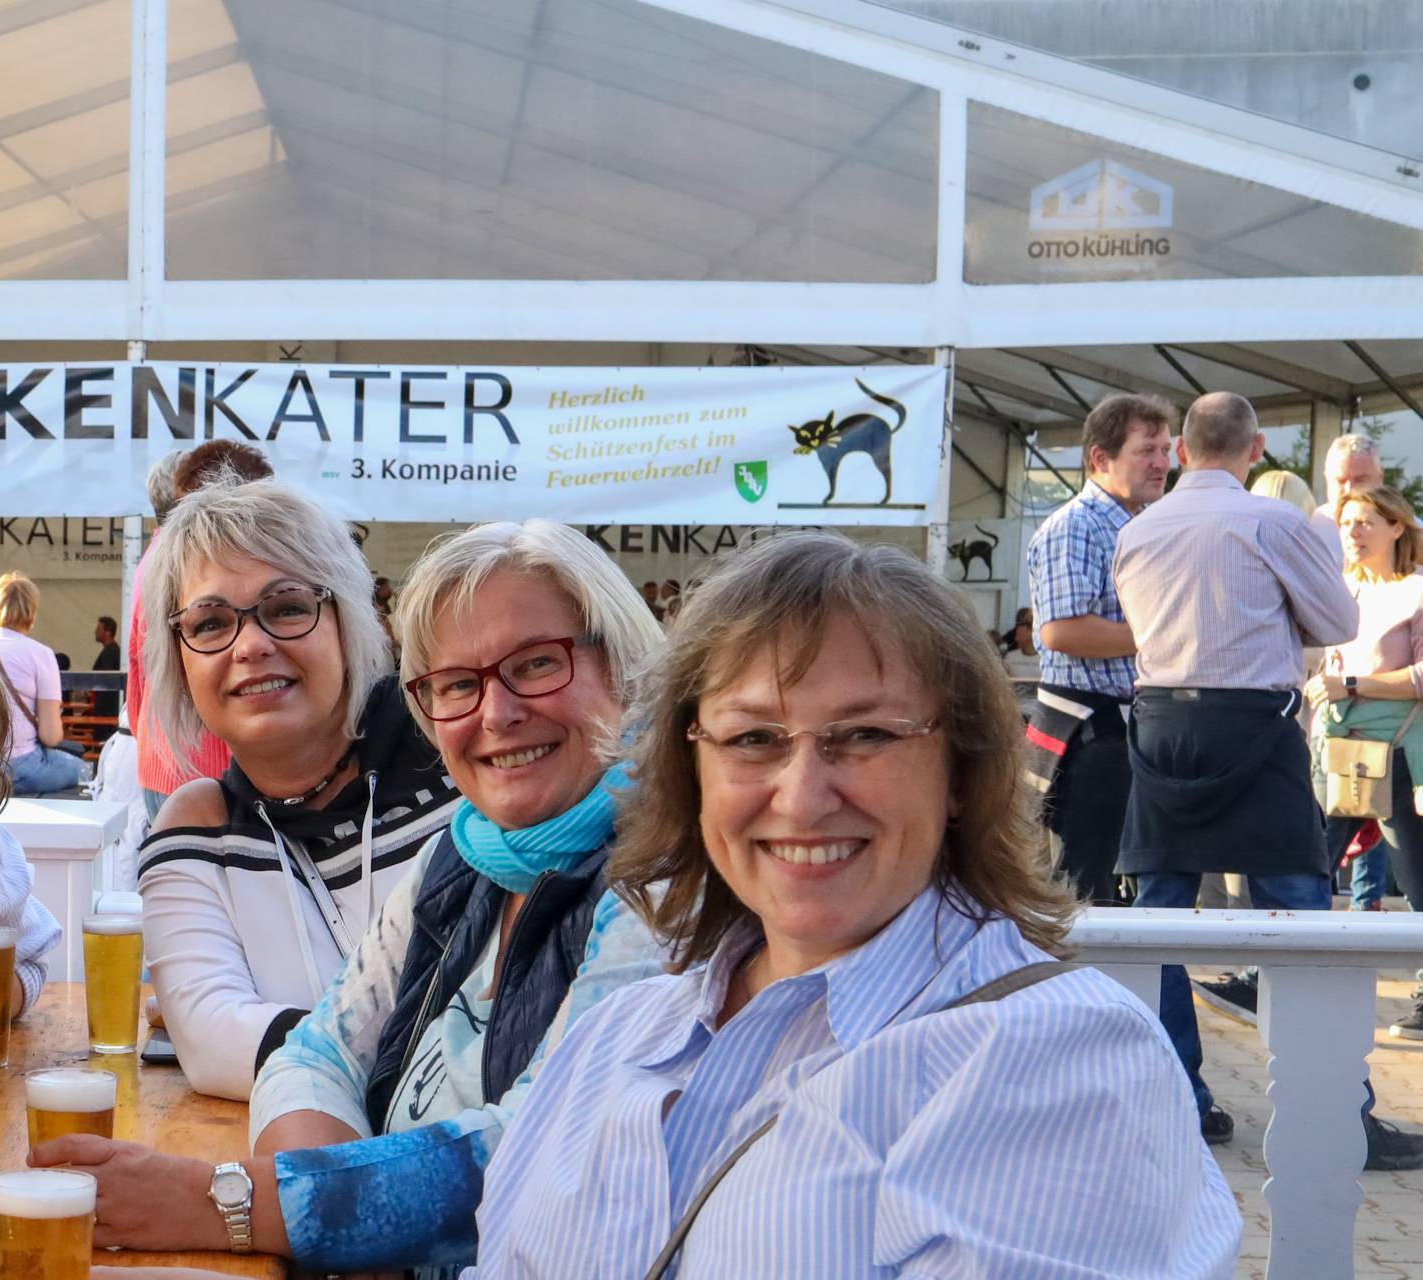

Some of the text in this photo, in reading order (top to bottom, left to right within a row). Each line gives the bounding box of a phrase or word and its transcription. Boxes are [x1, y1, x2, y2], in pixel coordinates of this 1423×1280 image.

[1028, 240, 1080, 258] OTTO
[547, 384, 645, 410] Herzlich
[548, 405, 748, 436] willkommen zum
[546, 431, 736, 462] Schützenfest im
[351, 458, 372, 480] 3.
[381, 459, 517, 484] Kompanie
[546, 456, 721, 489] Feuerwehrzelt!
[75, 551, 123, 564] Kompan
